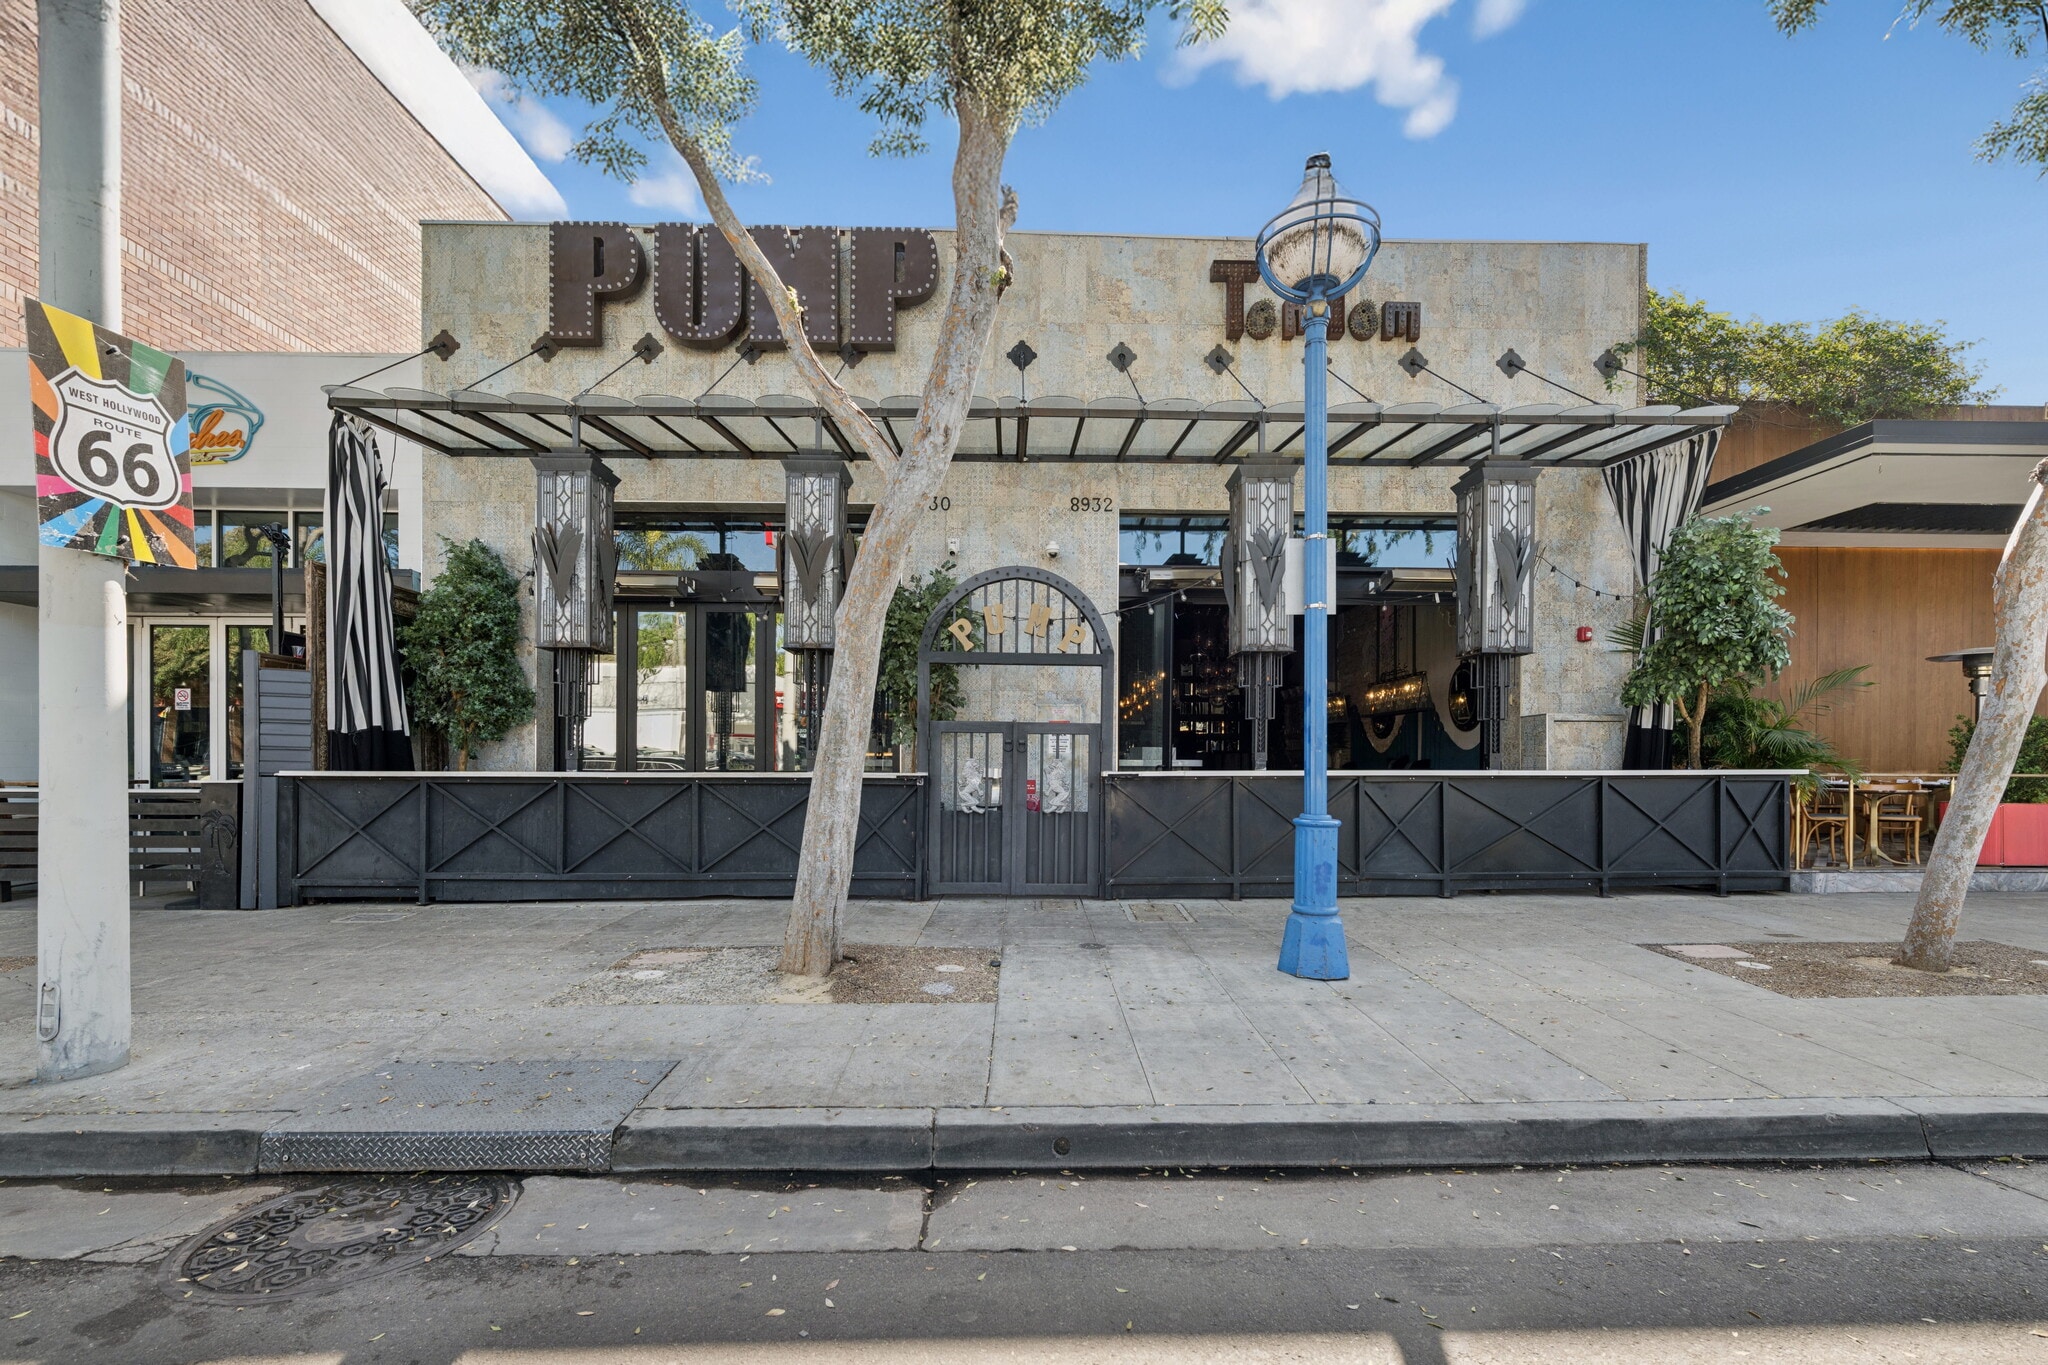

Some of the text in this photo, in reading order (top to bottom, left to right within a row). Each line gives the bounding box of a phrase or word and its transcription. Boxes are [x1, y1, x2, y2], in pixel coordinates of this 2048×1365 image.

[549, 221, 940, 350] PUMP
[69, 387, 161, 425] WEST HOLLYWOOD
[93, 418, 142, 439] ROUTE
[78, 430, 160, 497] 66
[929, 496, 950, 511] 30
[1070, 497, 1113, 512] 8932
[948, 603, 1087, 653] PUMP
